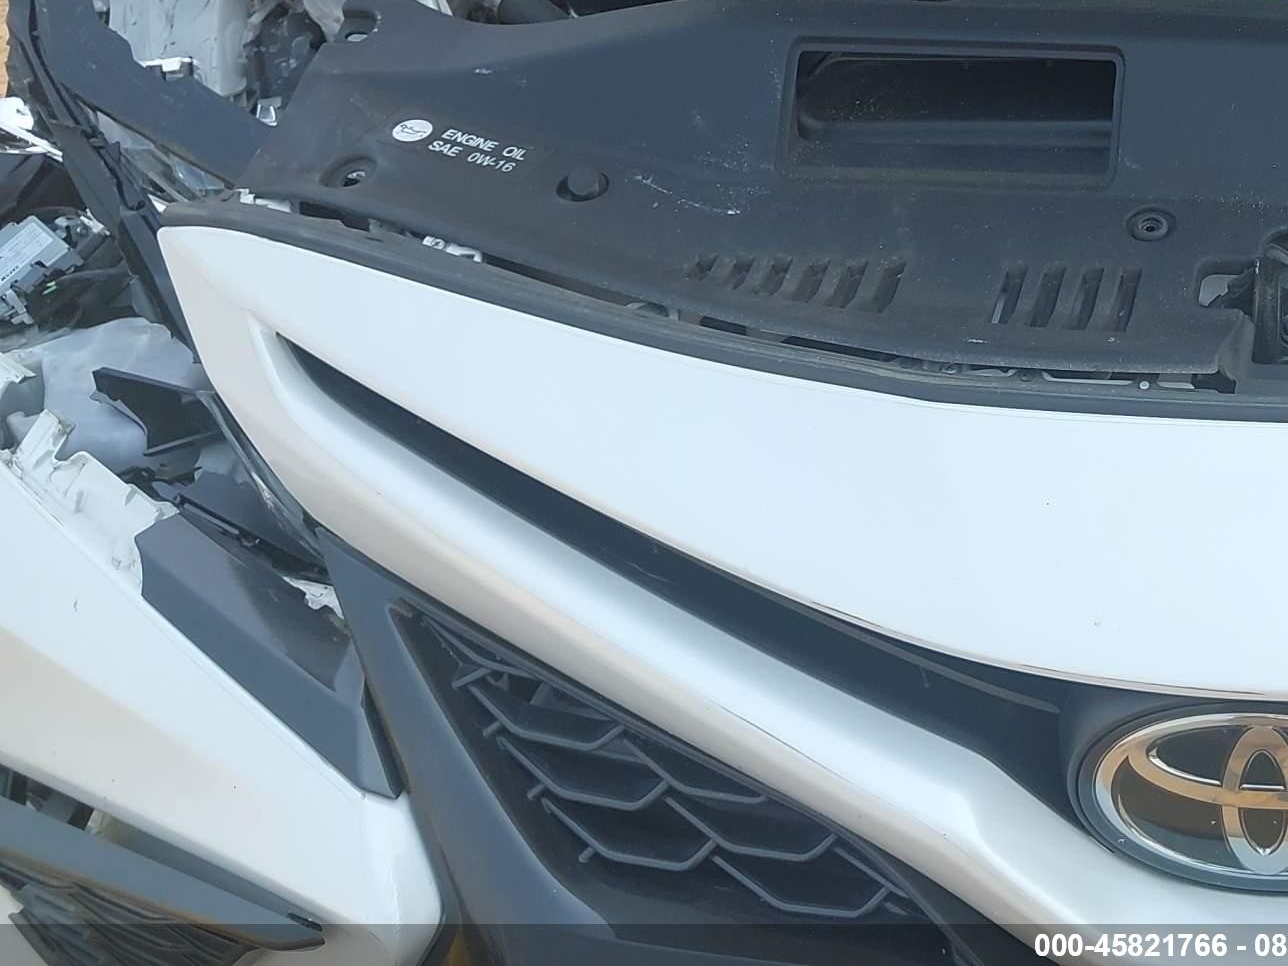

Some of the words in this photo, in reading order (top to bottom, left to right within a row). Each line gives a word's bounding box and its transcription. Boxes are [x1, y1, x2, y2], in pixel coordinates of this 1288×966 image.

[428, 140, 464, 158] SAE
[467, 152, 517, 173] 0W-16
[441, 128, 499, 152] ENGINE
[502, 146, 528, 161] OIL
